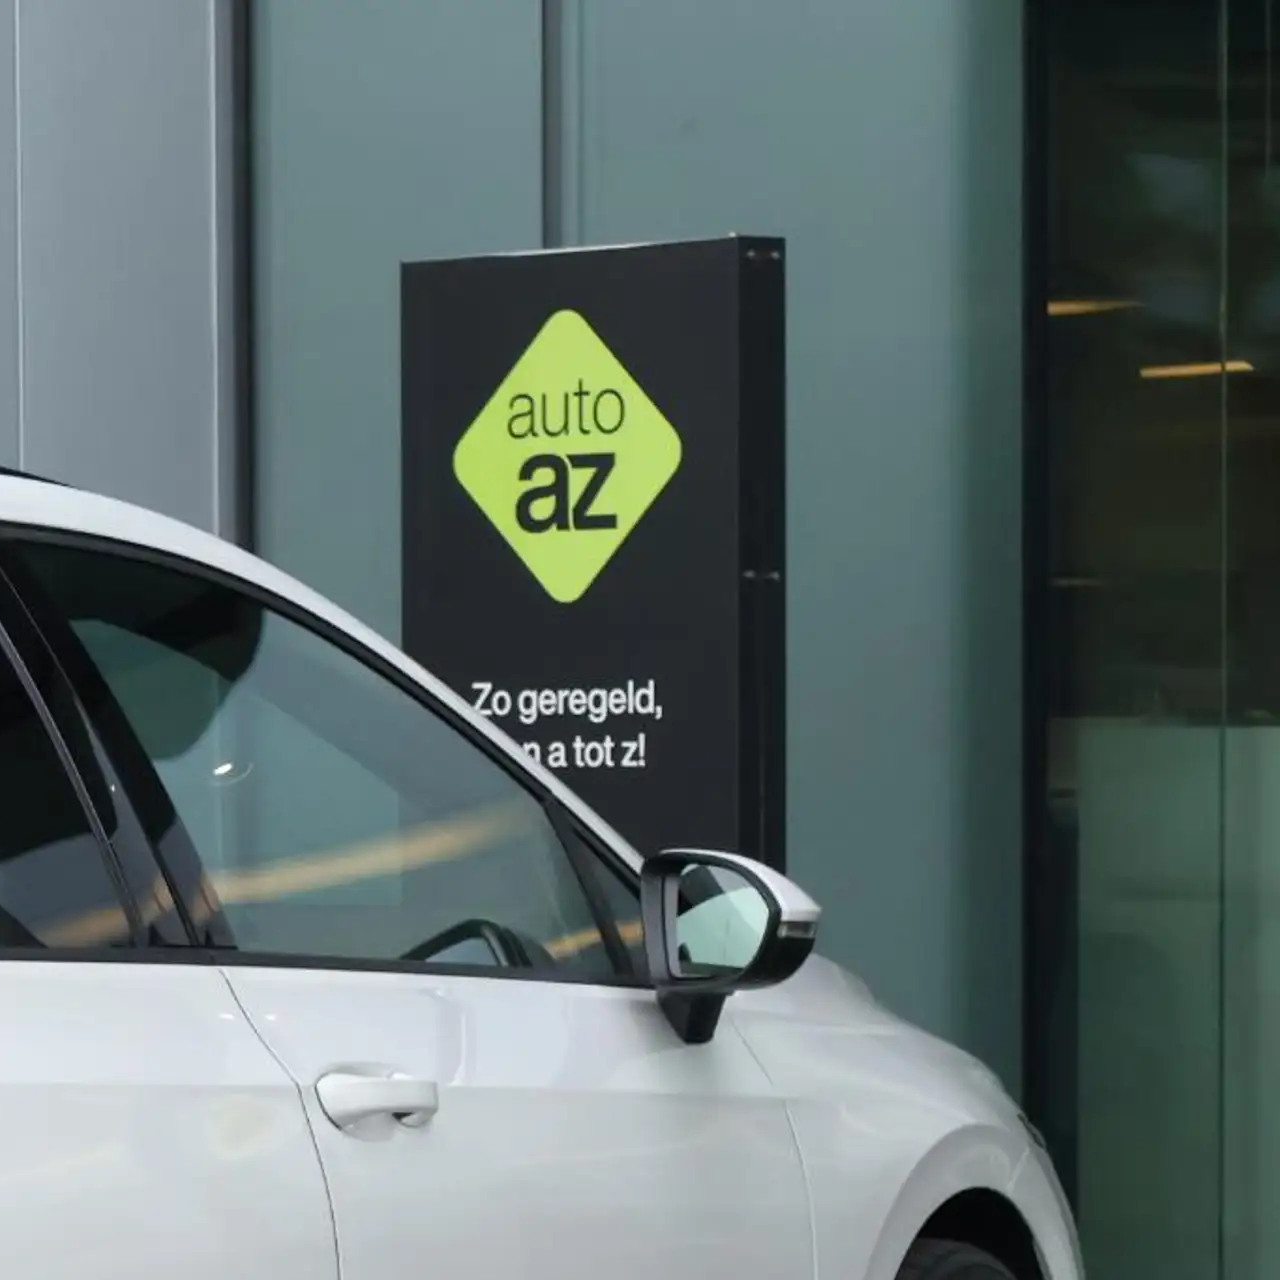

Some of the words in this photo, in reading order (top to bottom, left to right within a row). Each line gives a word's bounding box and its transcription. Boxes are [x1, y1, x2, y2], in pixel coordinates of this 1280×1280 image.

[507, 378, 626, 439] auto
[515, 452, 618, 534] az
[471, 682, 512, 717] Zo
[517, 679, 663, 725] geregeld,
[547, 741, 568, 768] a
[572, 735, 615, 768] tot
[620, 732, 646, 767] z!
